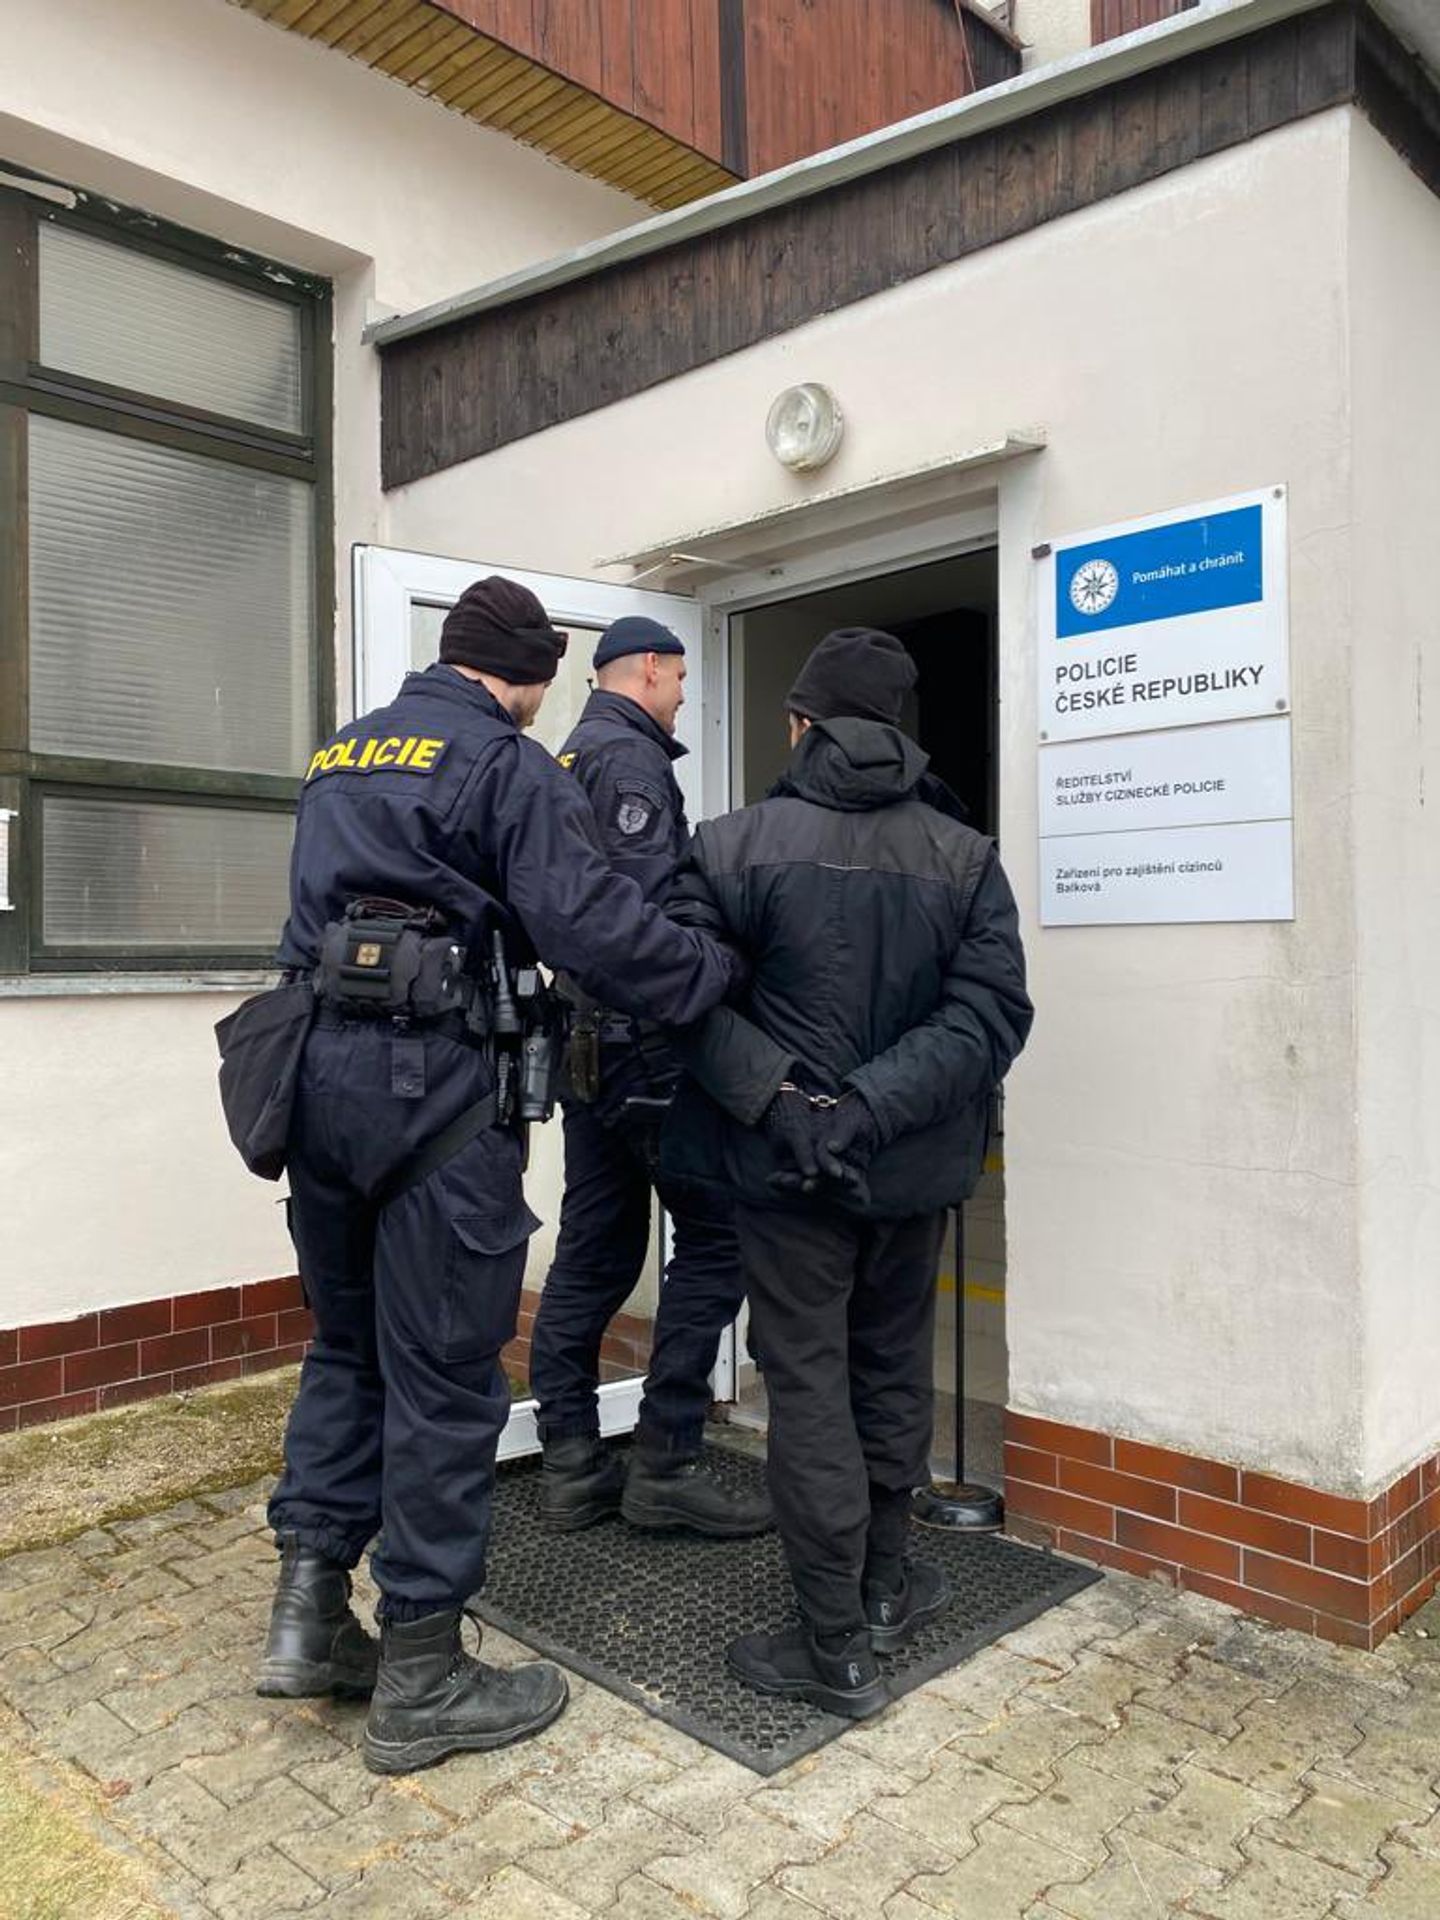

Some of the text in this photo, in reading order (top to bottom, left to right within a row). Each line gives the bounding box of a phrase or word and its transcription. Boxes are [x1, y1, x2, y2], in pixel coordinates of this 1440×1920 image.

[1132, 551, 1245, 585] Pomáhat a chránit
[1056, 654, 1137, 684] POLICIE
[1055, 665, 1264, 714] ČESKÉ REPUBLIKY
[305, 735, 445, 782] POLICIE
[1056, 769, 1132, 789] ŘEDITELSTVÍ
[1056, 780, 1226, 806] SLUŽBY CIZINECKÉ POLICIE
[1102, 867, 1122, 878] pro
[1125, 862, 1175, 878] zajištění
[1177, 858, 1223, 873] cizinců
